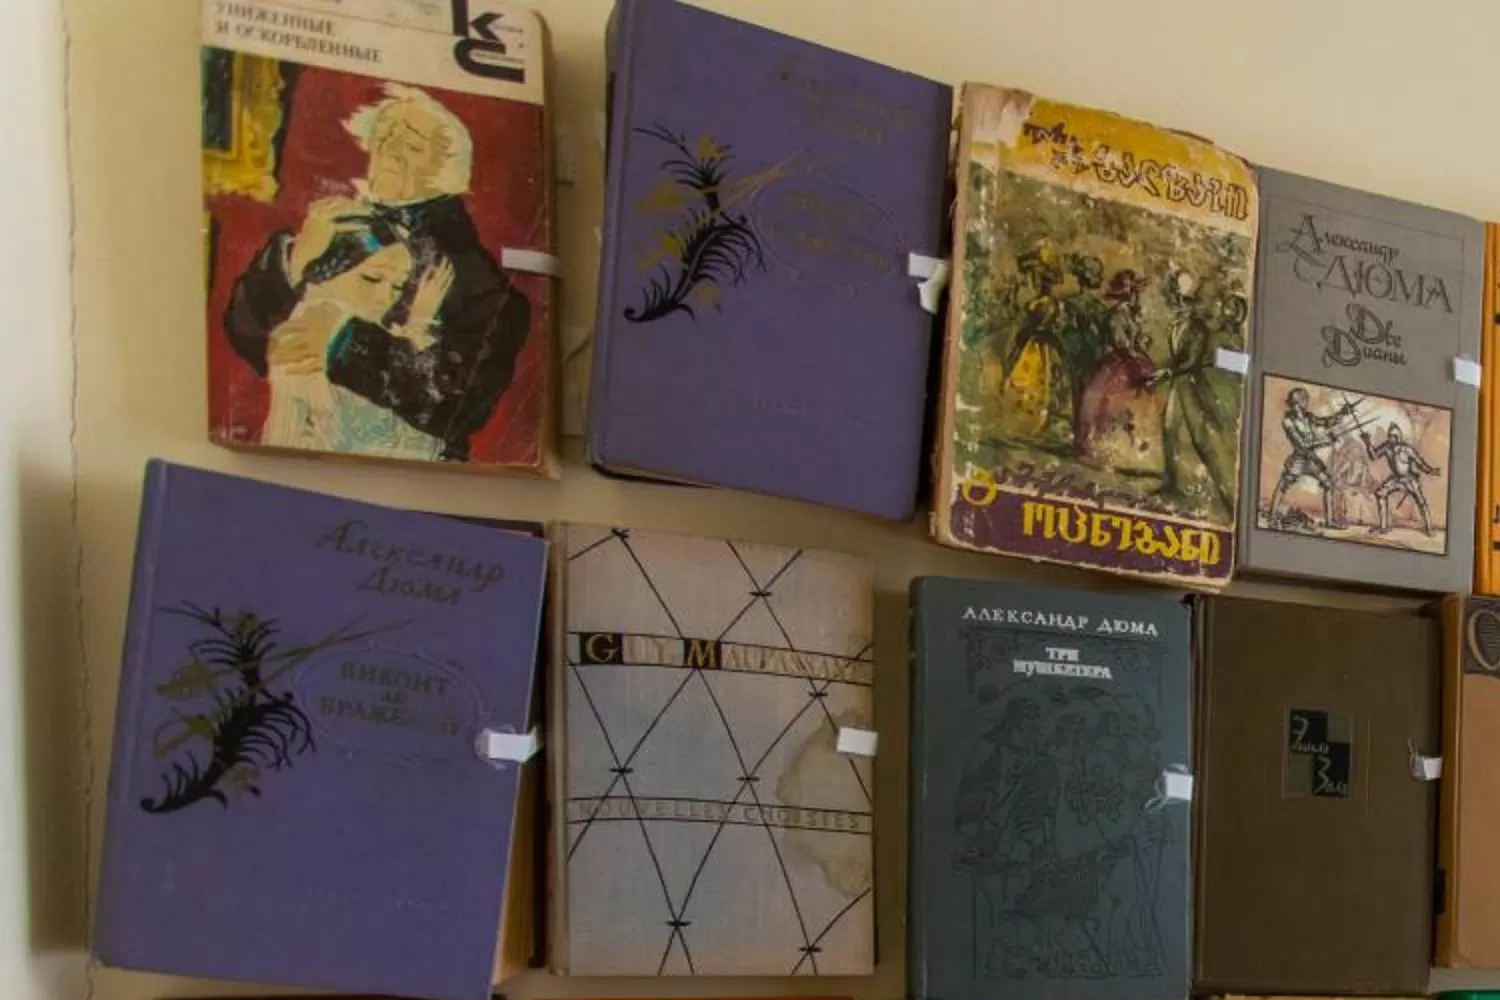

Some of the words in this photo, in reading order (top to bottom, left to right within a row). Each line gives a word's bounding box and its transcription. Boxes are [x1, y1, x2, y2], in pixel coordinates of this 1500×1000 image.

[1294, 255, 1453, 314] ДЮМА
[961, 605, 1090, 631] АЛЕКСАНДР
[1096, 618, 1159, 637] ДЮМА
[1046, 647, 1079, 662] ТРИ
